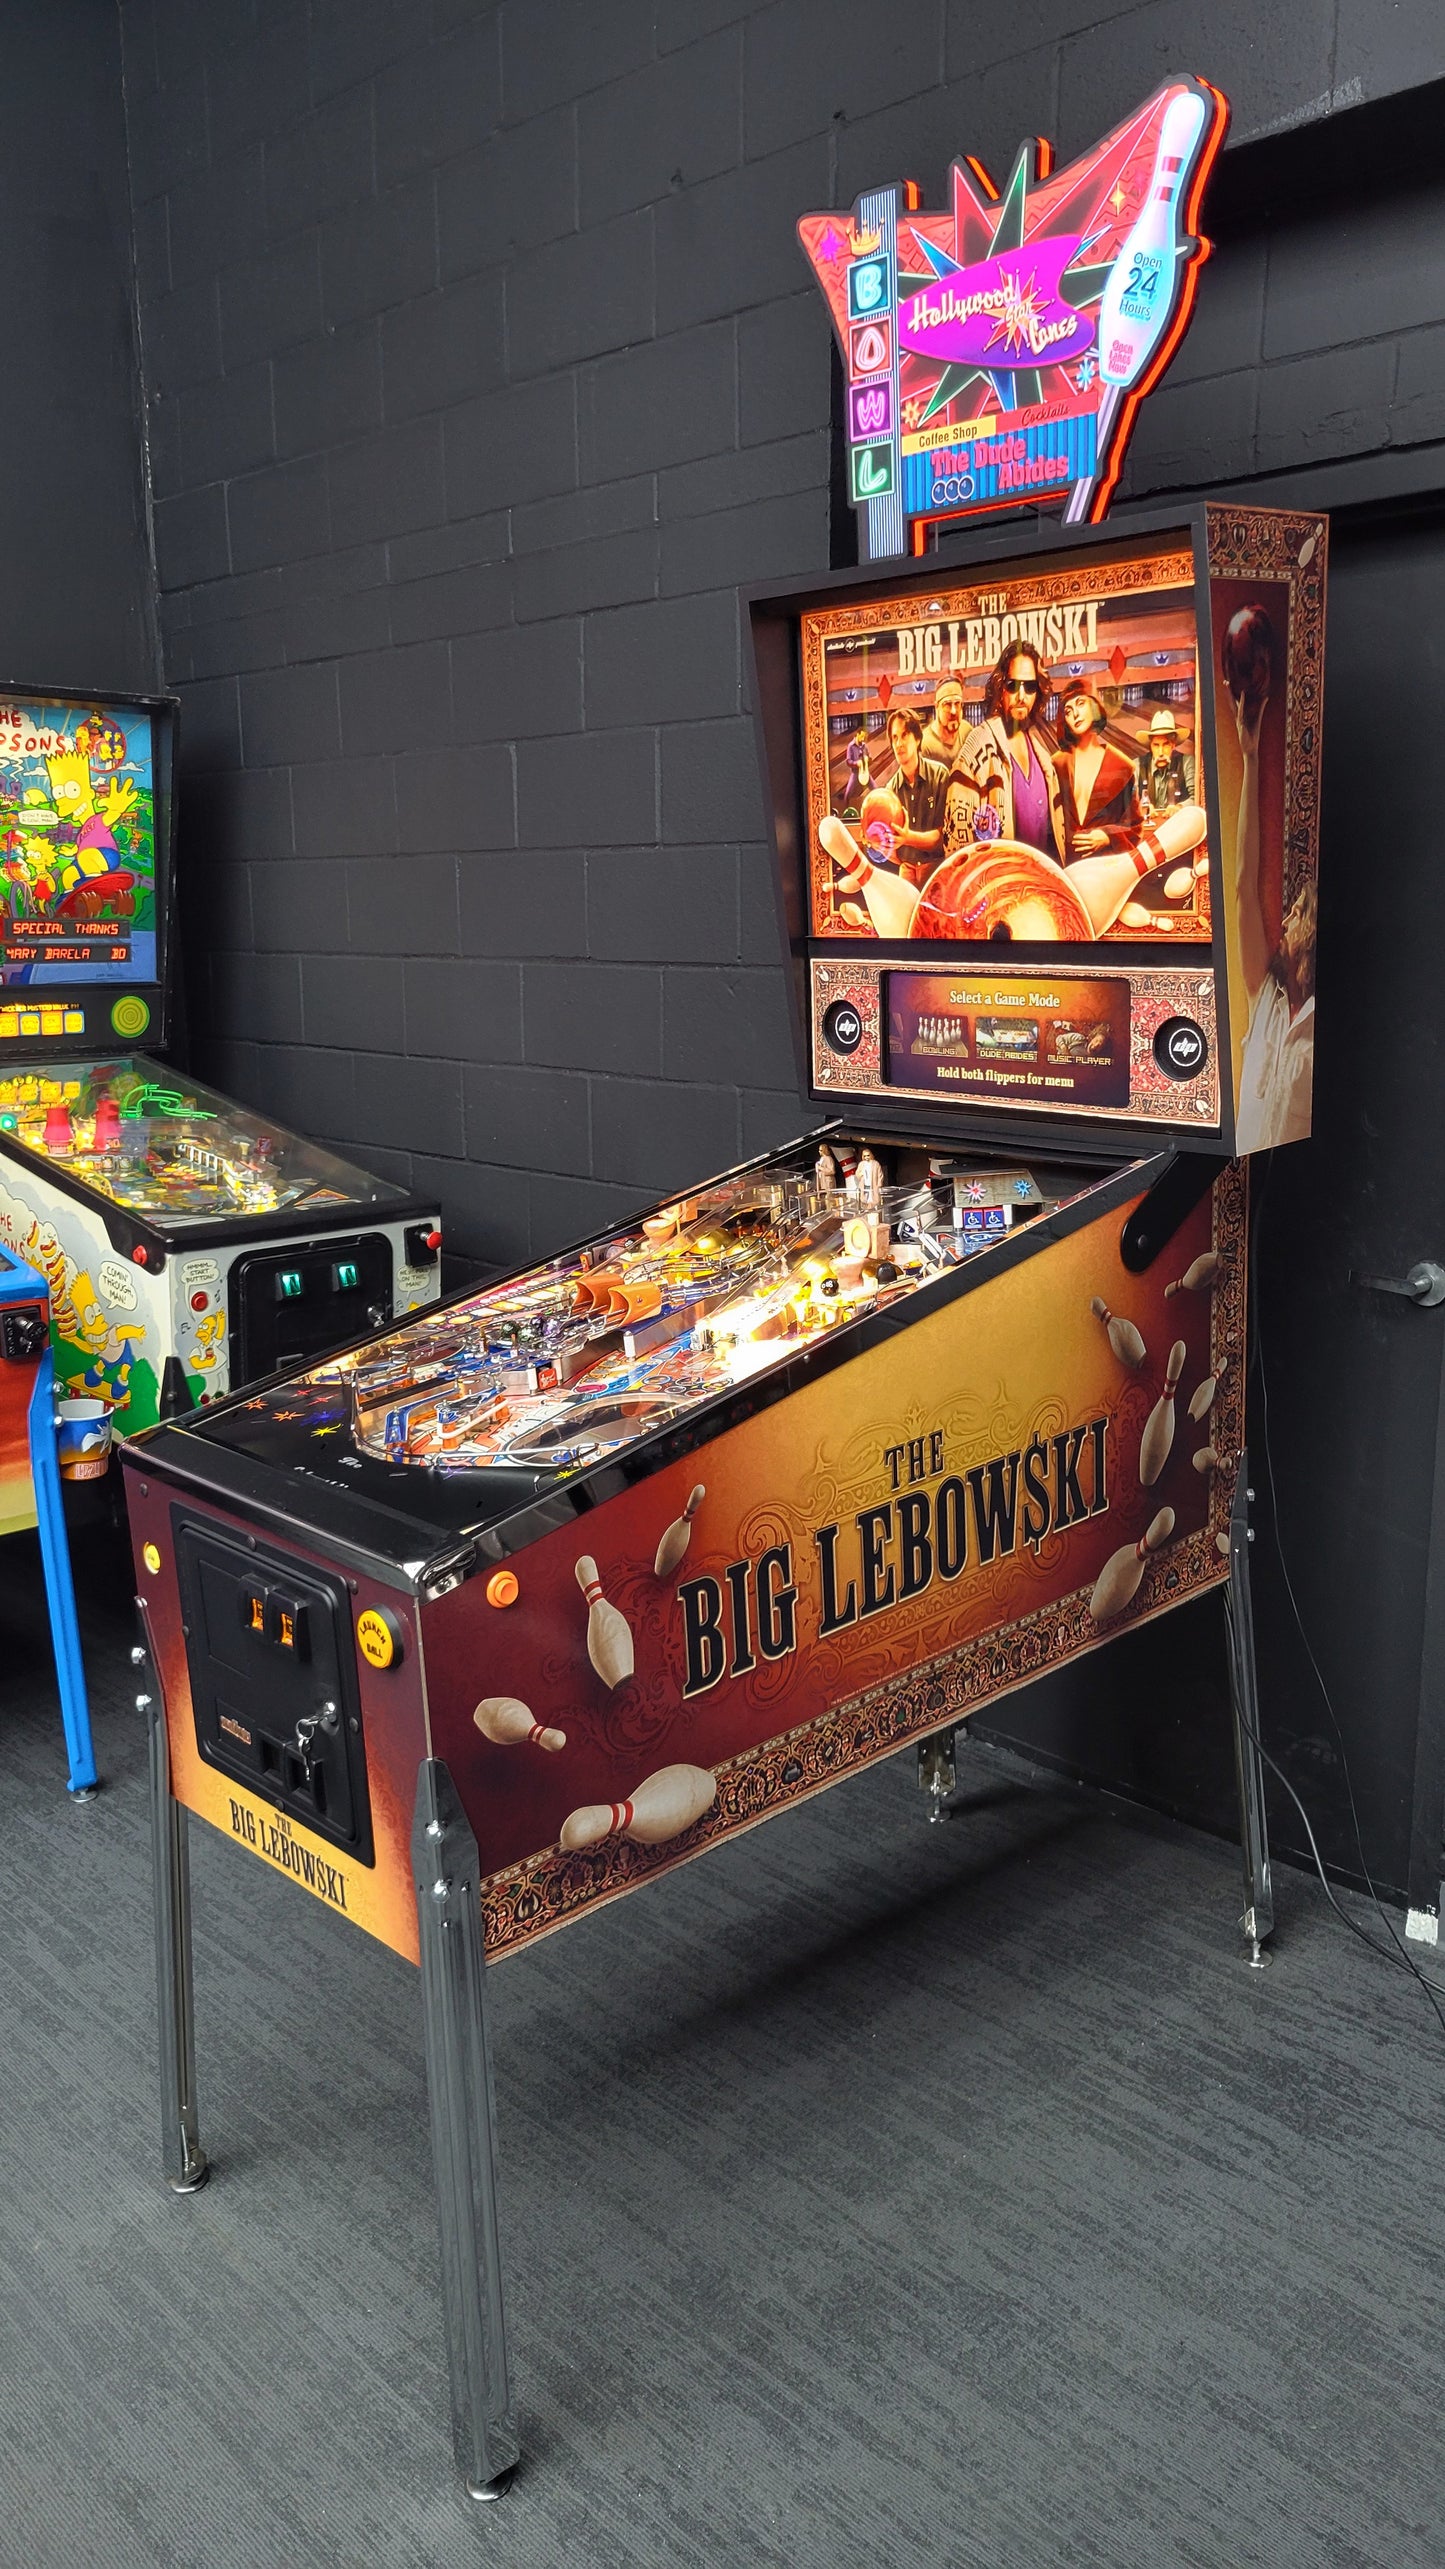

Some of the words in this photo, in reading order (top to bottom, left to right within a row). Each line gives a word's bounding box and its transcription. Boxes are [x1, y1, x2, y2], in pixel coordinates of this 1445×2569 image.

[1133, 252, 1162, 268] Open
[1123, 267, 1159, 300] 24
[907, 274, 1015, 333] Hollywood
[1005, 301, 1034, 328] Star
[1119, 299, 1151, 317] Hours
[1109, 350, 1131, 366] Lanes
[1021, 402, 1070, 427] Cocktails
[919, 432, 949, 447] Coffee
[953, 425, 978, 440] Shop
[931, 450, 969, 478] The
[974, 435, 1026, 469] Dude
[998, 454, 1069, 489] Abides
[978, 592, 1007, 617] THE
[897, 624, 943, 677] BIG
[13, 922, 66, 935] SPECIAL
[75, 923, 119, 935] THANKS
[44, 947, 91, 960] BARELA
[950, 990, 983, 1005] Select
[985, 996, 992, 1005] a
[994, 992, 1026, 1007] Game
[1028, 993, 1061, 1008] Mode
[922, 1046, 956, 1056] BOWLING
[979, 1050, 1002, 1059] DUDE
[1004, 1051, 1035, 1060] ABIDES
[1047, 1054, 1072, 1064] MUSIC
[1075, 1056, 1112, 1066] PLAYER
[937, 1067, 960, 1079] Hold
[961, 1067, 984, 1081] both
[985, 1069, 1026, 1086] flippers
[1026, 1072, 1043, 1085] for
[1044, 1076, 1074, 1088] menu
[883, 1428, 946, 1492] THE
[359, 1620, 387, 1645] LAUNCH
[677, 1542, 800, 1700] BIG
[366, 1642, 383, 1659] BALL
[229, 1798, 257, 1847] BIG
[275, 1813, 293, 1837] THE
